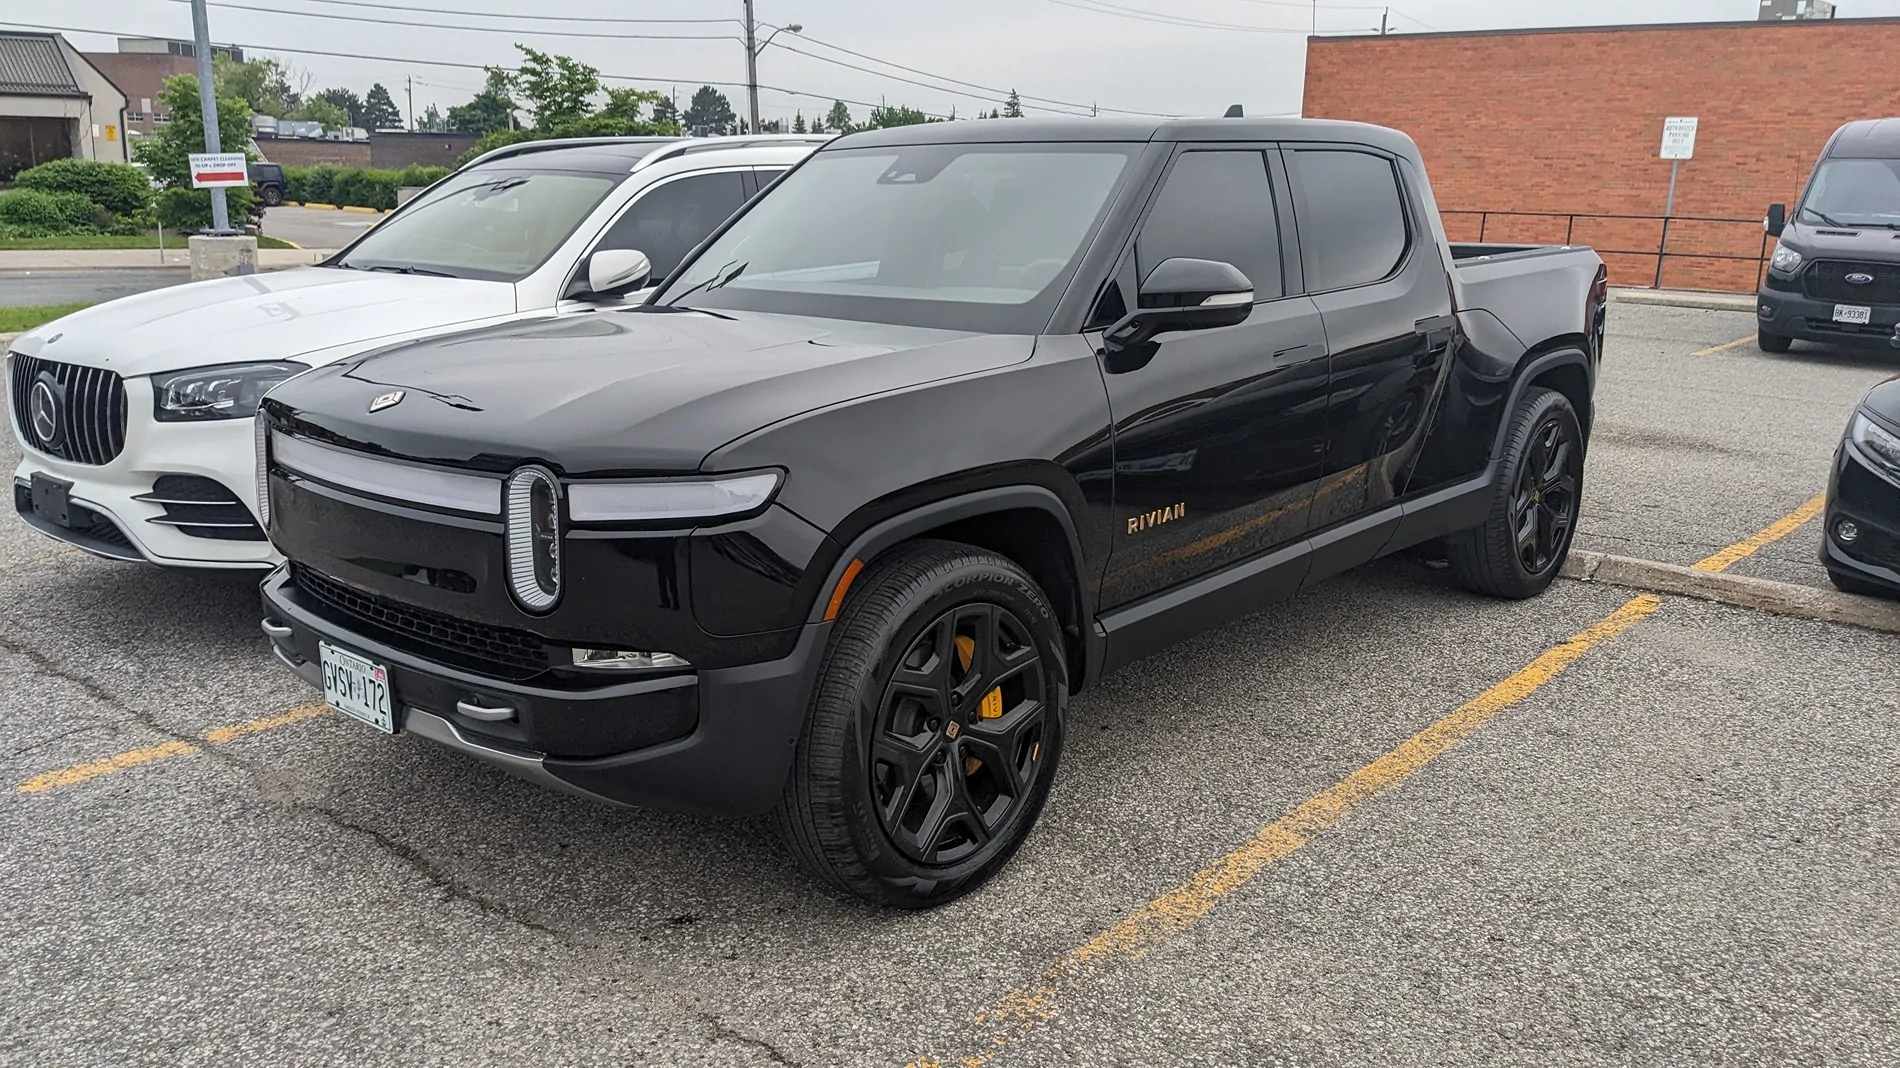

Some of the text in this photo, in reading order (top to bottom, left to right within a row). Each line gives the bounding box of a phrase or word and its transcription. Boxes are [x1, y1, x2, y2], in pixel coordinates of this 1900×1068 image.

[1127, 502, 1186, 535] RIVIAN
[1016, 583, 1049, 619] ZERO
[340, 655, 367, 673] ONTARIO
